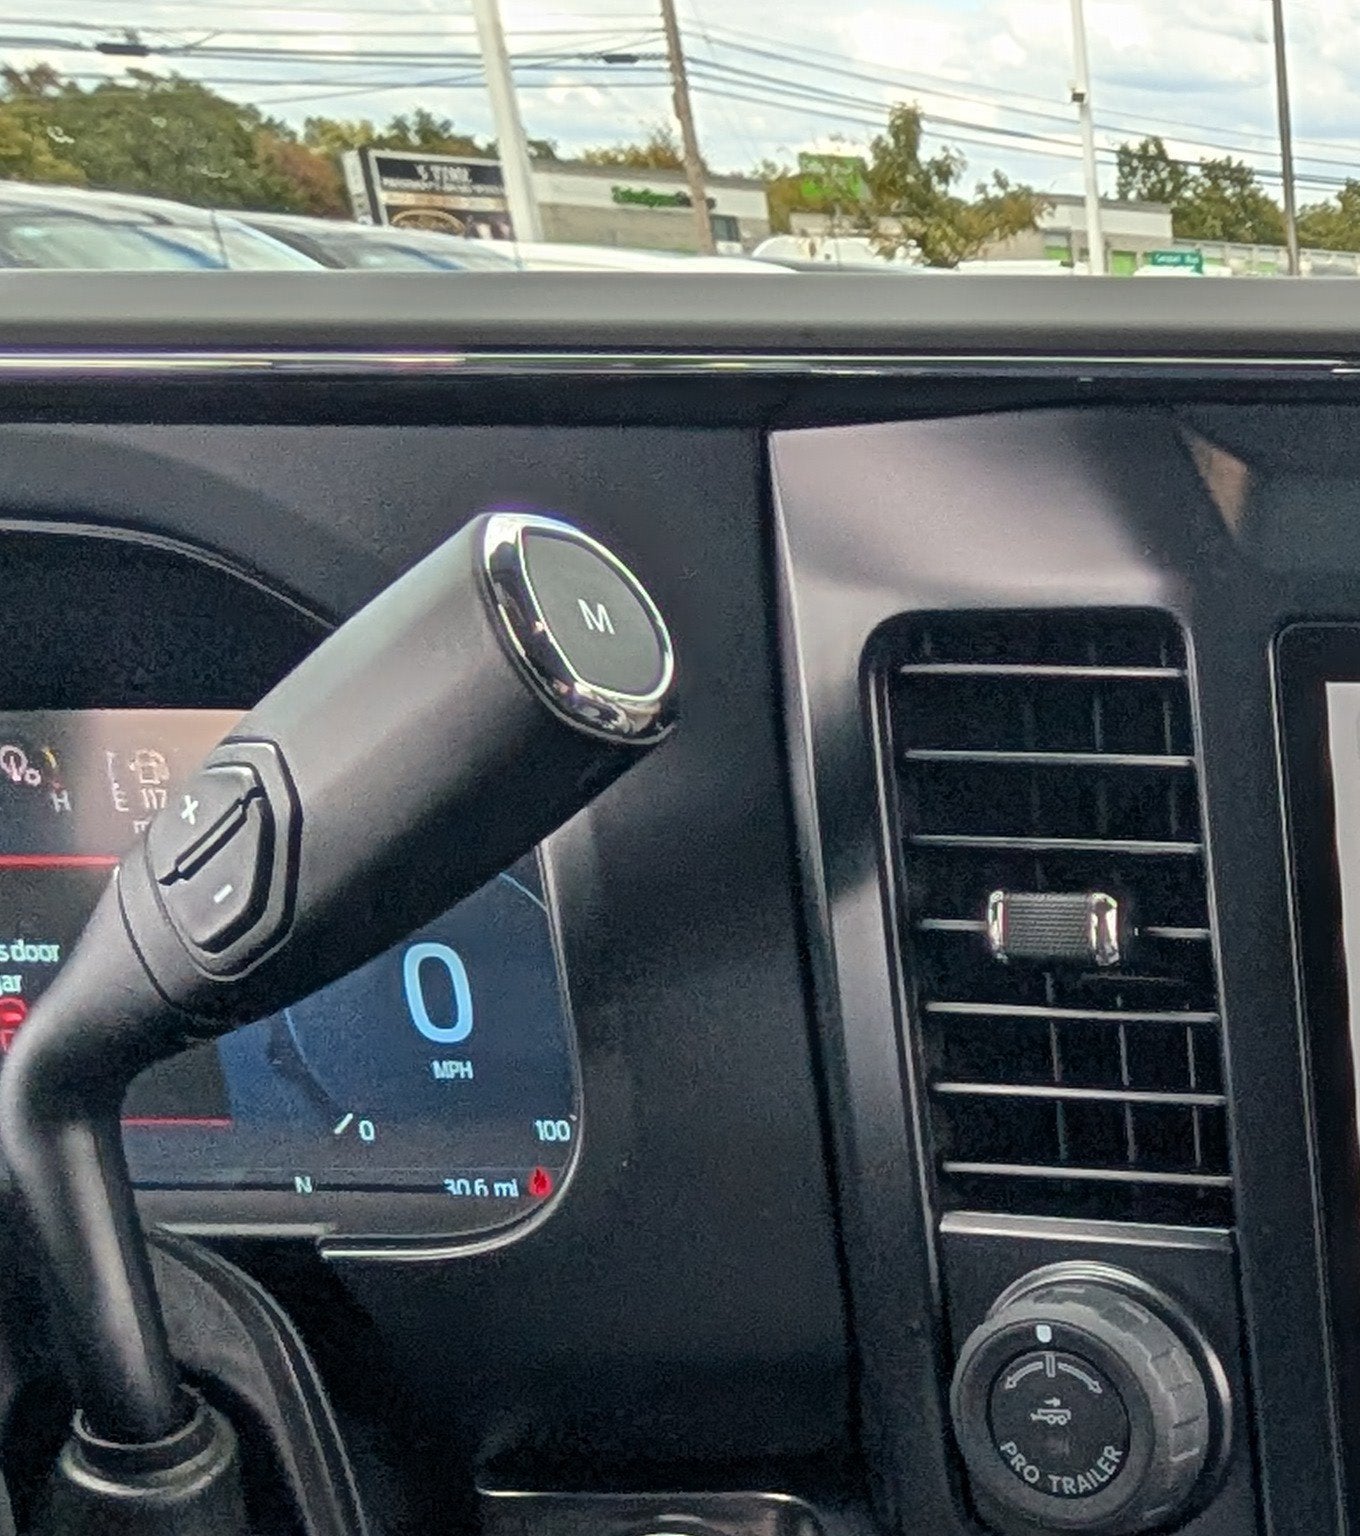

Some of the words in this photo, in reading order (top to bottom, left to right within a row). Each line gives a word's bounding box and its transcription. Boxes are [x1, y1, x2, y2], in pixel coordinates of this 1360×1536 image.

[580, 599, 615, 635] M
[401, 941, 474, 1044] 0
[432, 1060, 473, 1080] MPH
[358, 1120, 375, 1141] 0
[534, 1119, 570, 1141] 100
[294, 1176, 313, 1194] N
[1000, 1441, 1039, 1484] PRO
[1049, 1445, 1124, 1495] TRAILER
